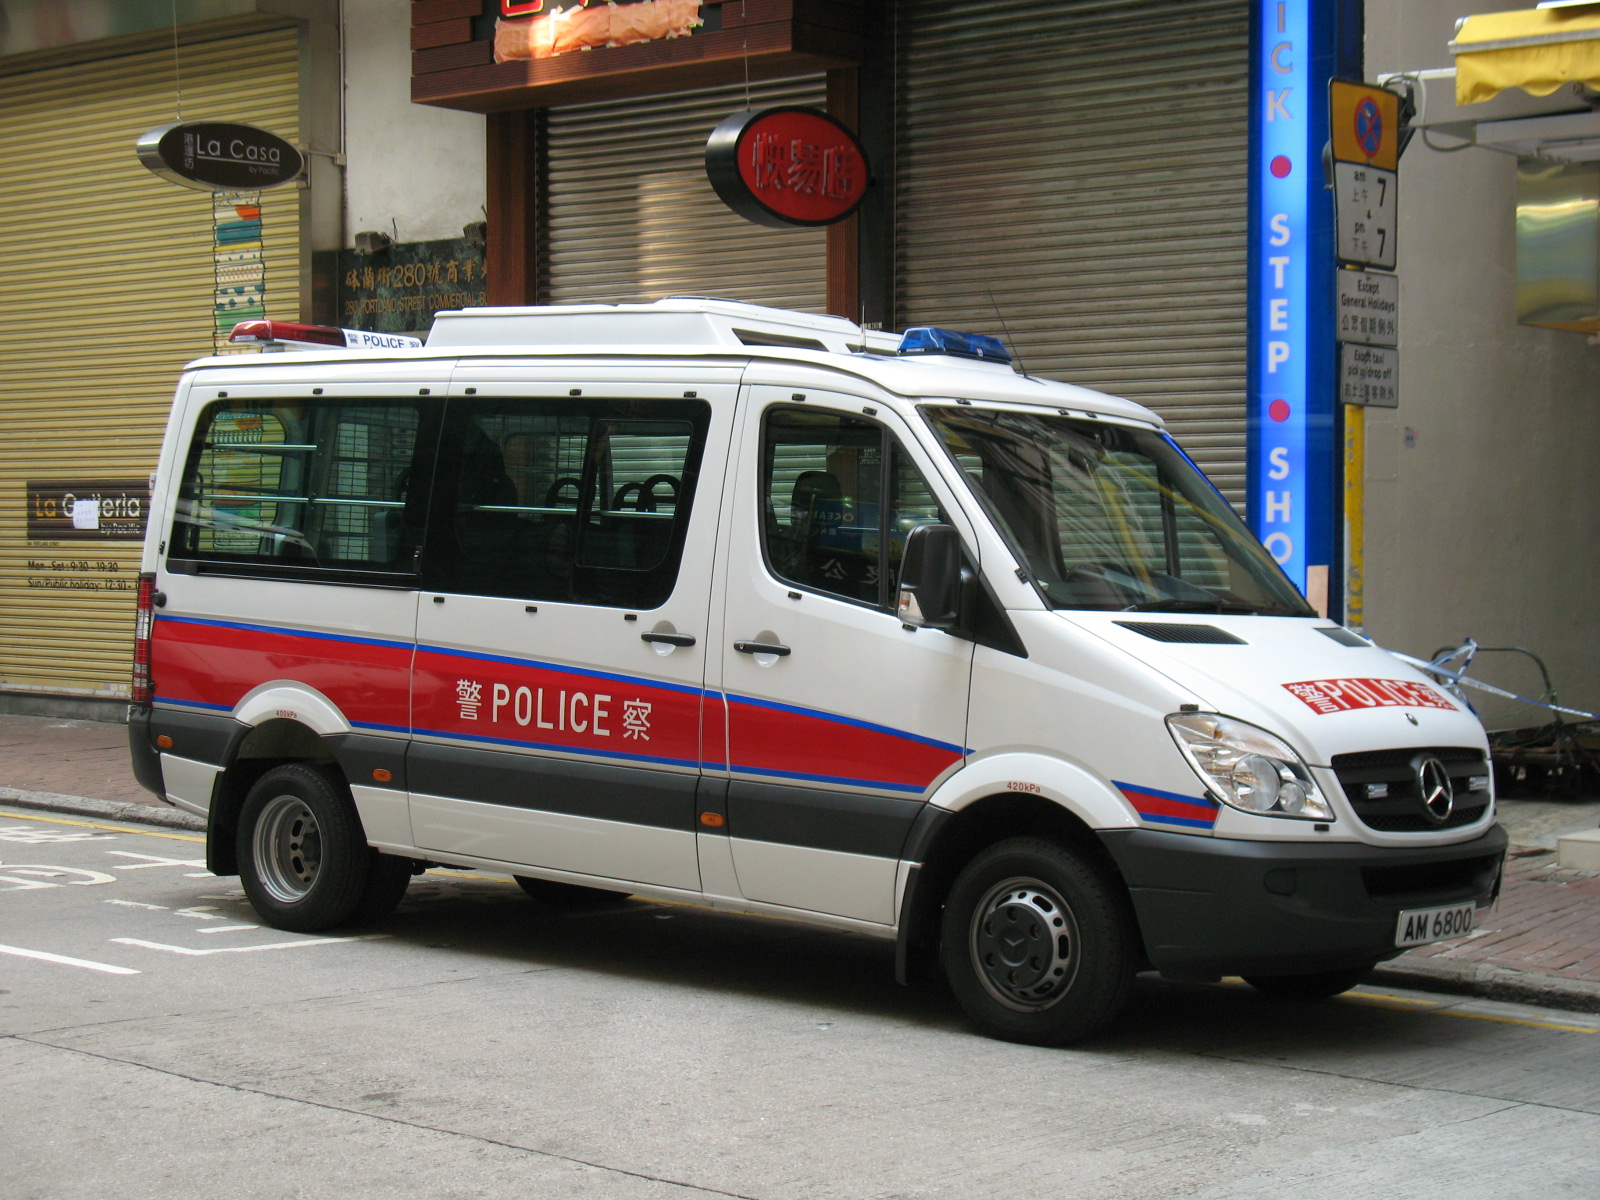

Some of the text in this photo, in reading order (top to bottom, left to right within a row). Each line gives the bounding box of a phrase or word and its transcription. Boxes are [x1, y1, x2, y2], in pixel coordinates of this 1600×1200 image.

[196, 134, 280, 162] La Casa
[1354, 171, 1366, 181] am
[1352, 187, 1368, 203] 上午
[1377, 176, 1387, 207] 7
[1352, 237, 1368, 252] 下午
[1377, 227, 1386, 258] 7
[1268, 213, 1291, 374] STEP
[1357, 280, 1380, 296] Except
[361, 298, 397, 314] PORTLAND
[400, 295, 426, 311] STREET
[429, 291, 476, 310] COMMERCIAL
[1341, 293, 1395, 314] General Holidays
[362, 334, 405, 349] POLICE
[36, 493, 57, 517] La
[28, 561, 45, 571] Mon
[70, 561, 89, 572] 9:30
[96, 561, 118, 572] 19:30
[28, 577, 69, 589] Sun/Public
[105, 579, 127, 591] 12:30
[456, 678, 483, 721] 警
[1288, 682, 1340, 714] 警
[1314, 678, 1437, 709] POLICE
[492, 682, 612, 737] POLICE
[622, 697, 652, 741] 察
[1006, 781, 1041, 793] 420kPa
[1403, 907, 1472, 942] AM 6800
